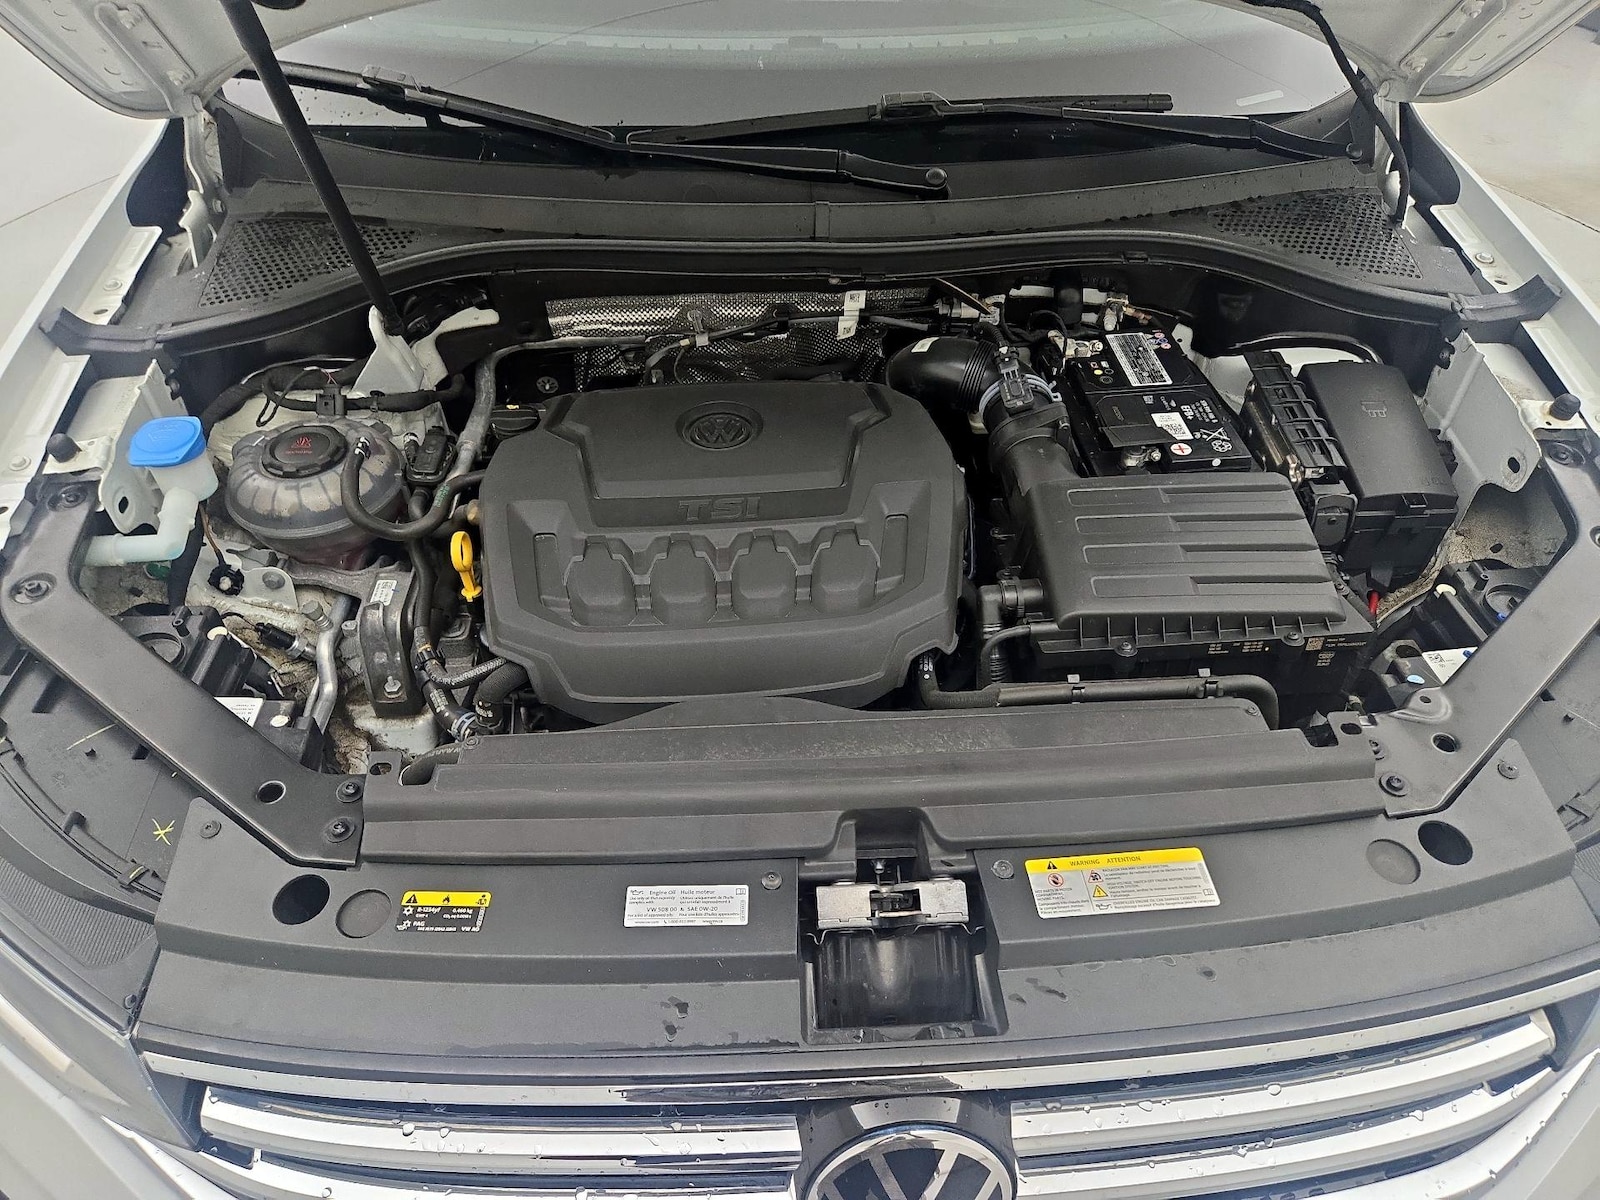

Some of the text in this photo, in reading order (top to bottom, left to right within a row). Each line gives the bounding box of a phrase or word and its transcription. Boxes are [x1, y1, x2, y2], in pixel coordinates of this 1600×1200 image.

[679, 497, 760, 520] TSI
[1069, 855, 1141, 867] WARNING ATTENTION
